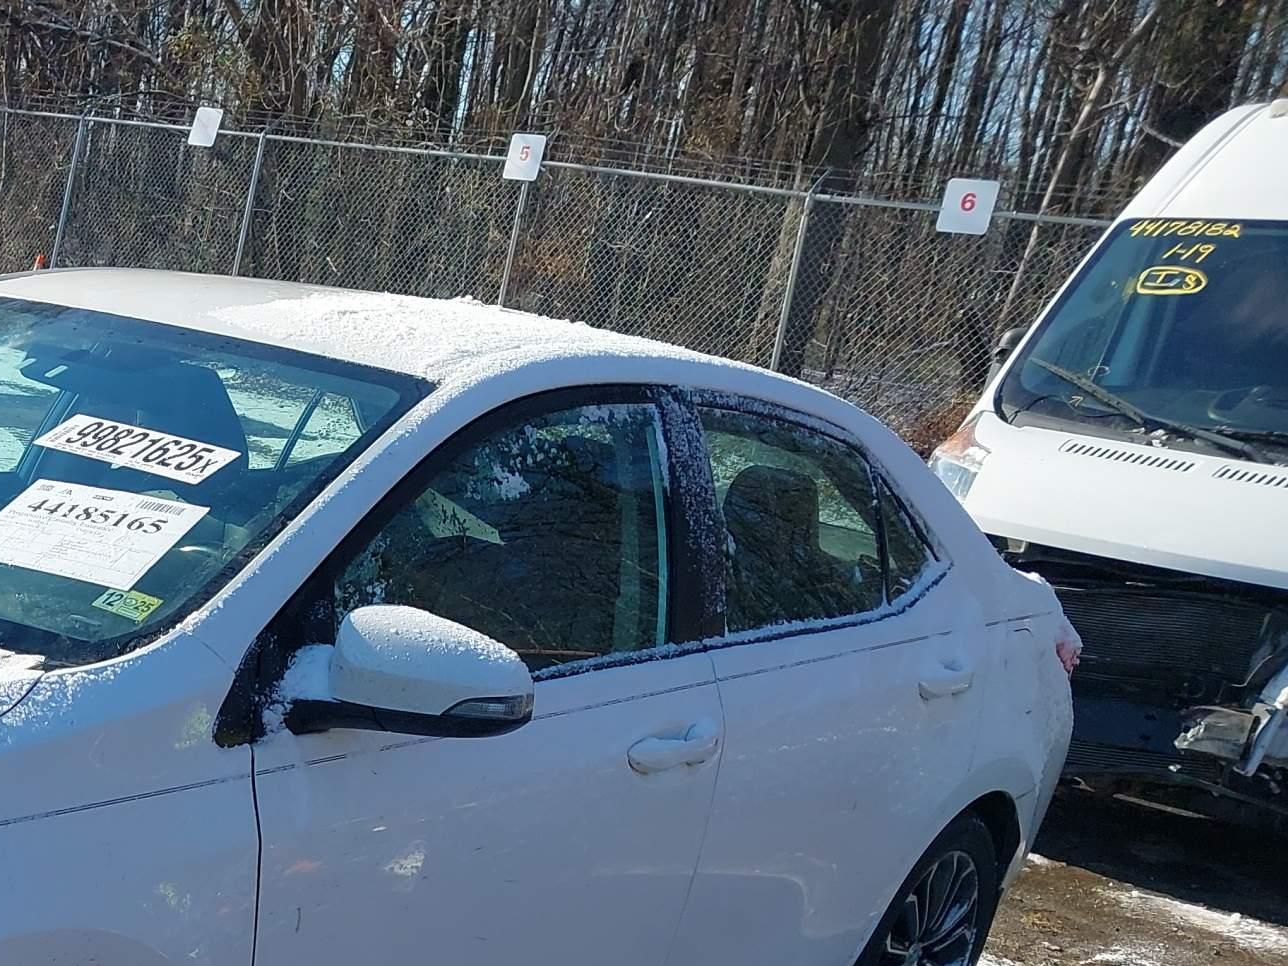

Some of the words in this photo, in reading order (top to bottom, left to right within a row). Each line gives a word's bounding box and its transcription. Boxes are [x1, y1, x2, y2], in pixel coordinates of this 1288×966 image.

[519, 145, 531, 161] 5
[960, 192, 977, 212] 6
[1129, 218, 1241, 238] 44178182
[1161, 241, 1216, 264] 1-19
[27, 498, 169, 535] 44185165
[102, 591, 124, 607] 12
[133, 600, 155, 613] 25
